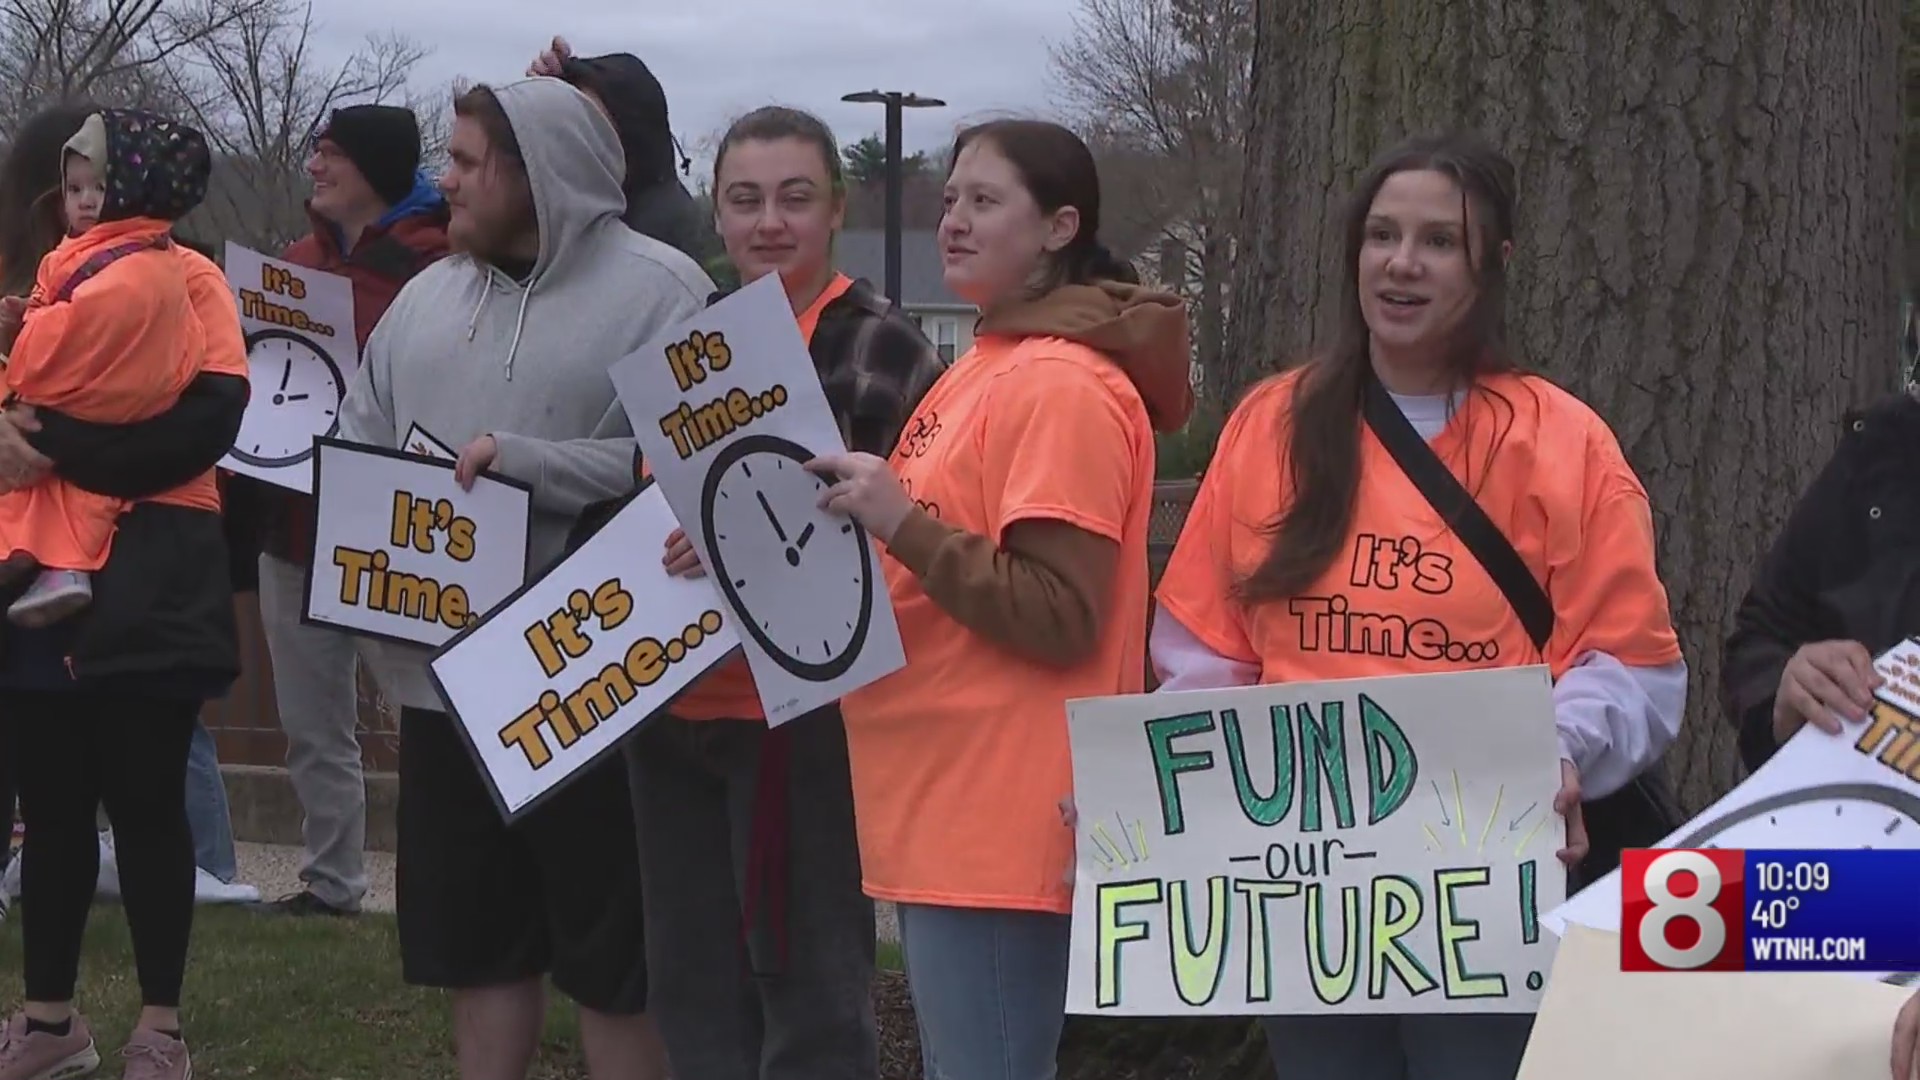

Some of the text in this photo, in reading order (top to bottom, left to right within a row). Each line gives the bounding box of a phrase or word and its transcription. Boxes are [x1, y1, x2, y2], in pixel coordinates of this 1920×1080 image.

[240, 289, 334, 337] Time...
[262, 263, 306, 299] It's
[665, 330, 732, 392] It's
[660, 384, 788, 459] Time...
[391, 490, 477, 561] It's
[1350, 534, 1454, 594] It's
[524, 578, 634, 677] It's
[1289, 595, 1499, 661] Time...
[499, 610, 722, 770] Time...
[1144, 693, 1418, 835] FUND
[1096, 861, 1543, 1008] FUTURE!
